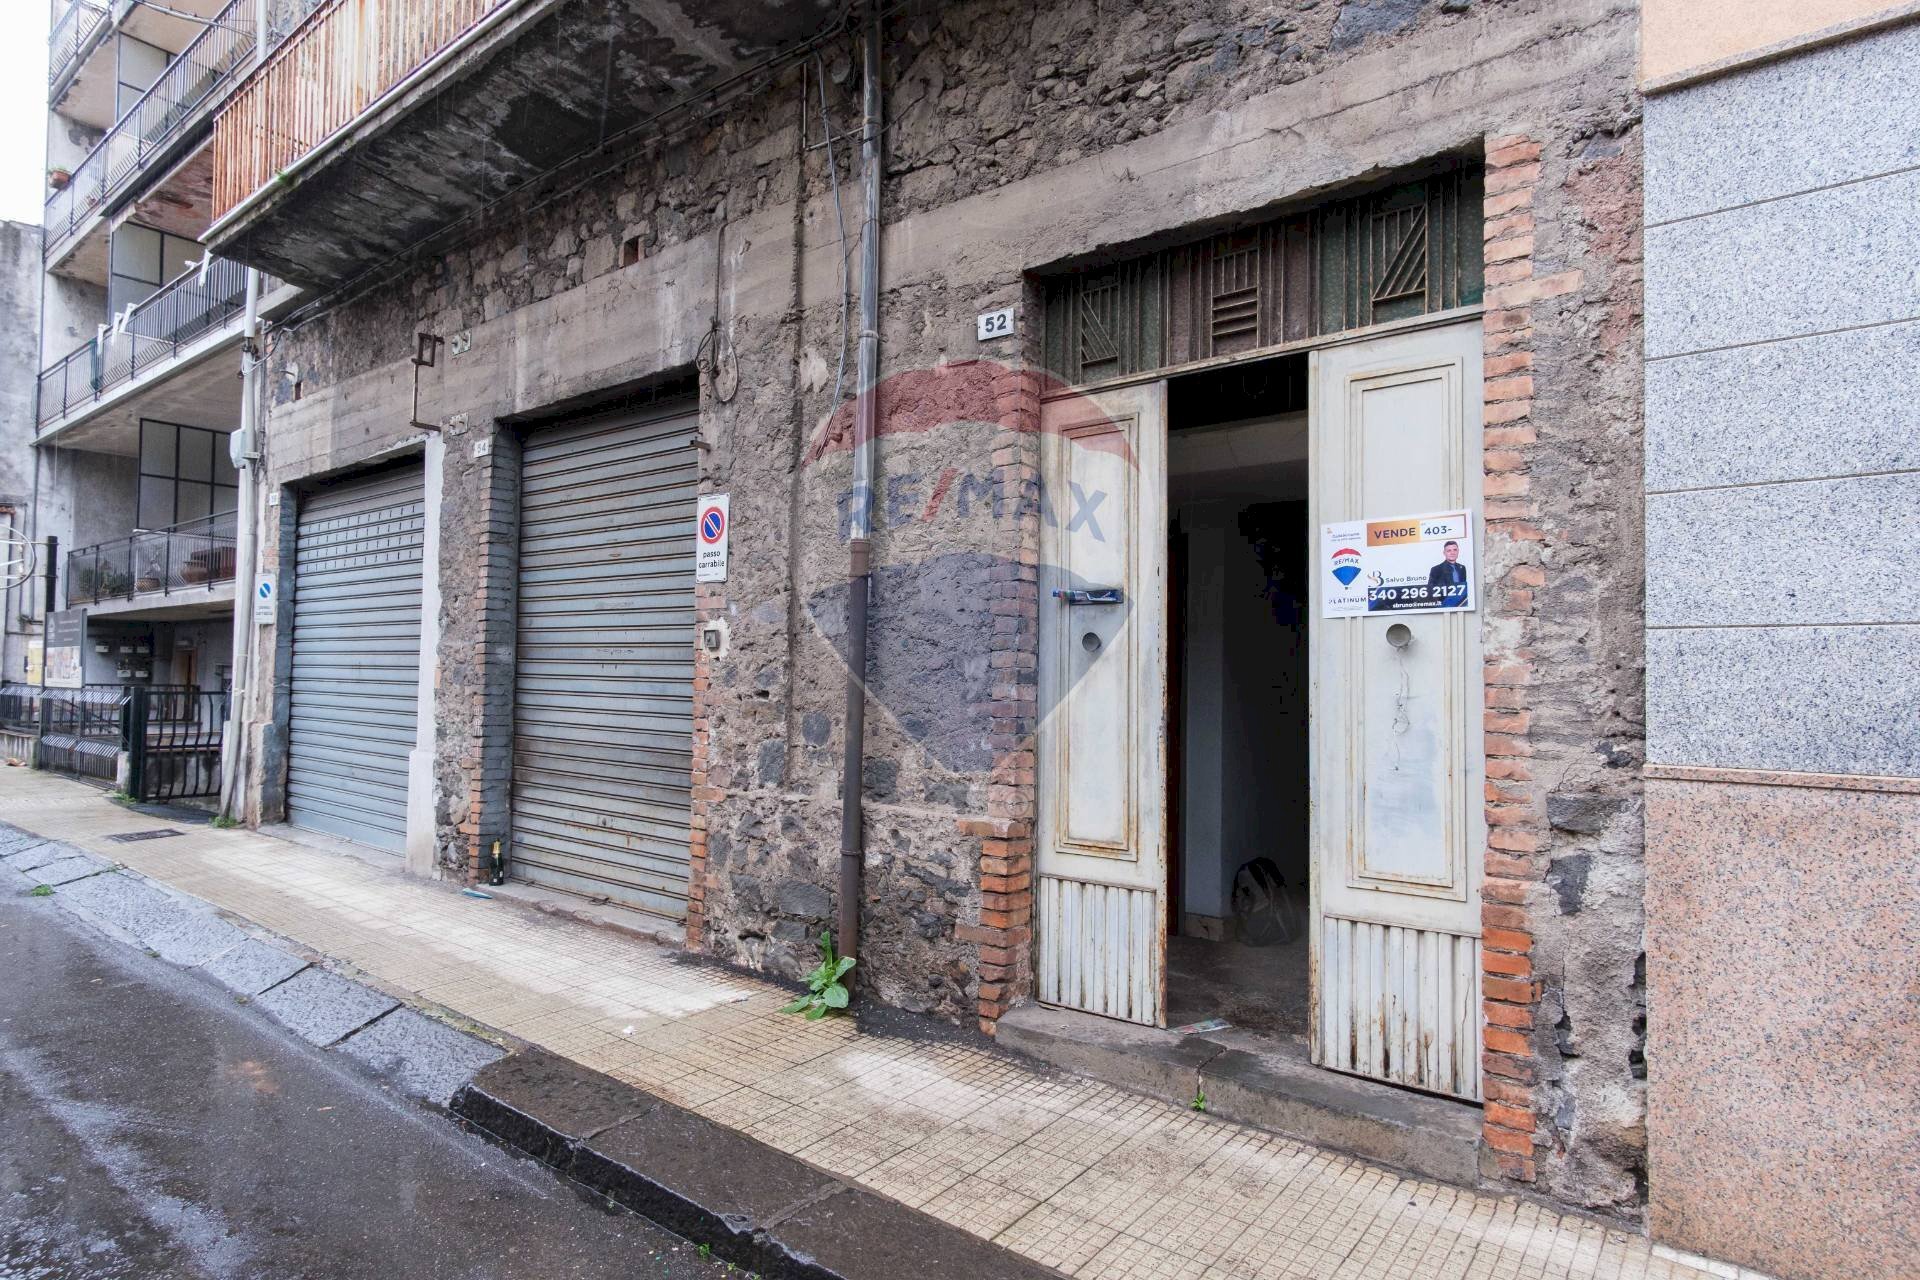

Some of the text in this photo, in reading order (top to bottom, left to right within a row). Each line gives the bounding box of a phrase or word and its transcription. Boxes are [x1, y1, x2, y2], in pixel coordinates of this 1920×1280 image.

[985, 313, 1007, 333] 52
[1374, 527, 1416, 539] VENDE
[703, 550, 721, 559] passo
[698, 559, 725, 569] carrabile
[1334, 558, 1360, 566] RE/MAX
[1385, 576, 1405, 584] Salvo
[1369, 585, 1466, 601] 340 296 2127
